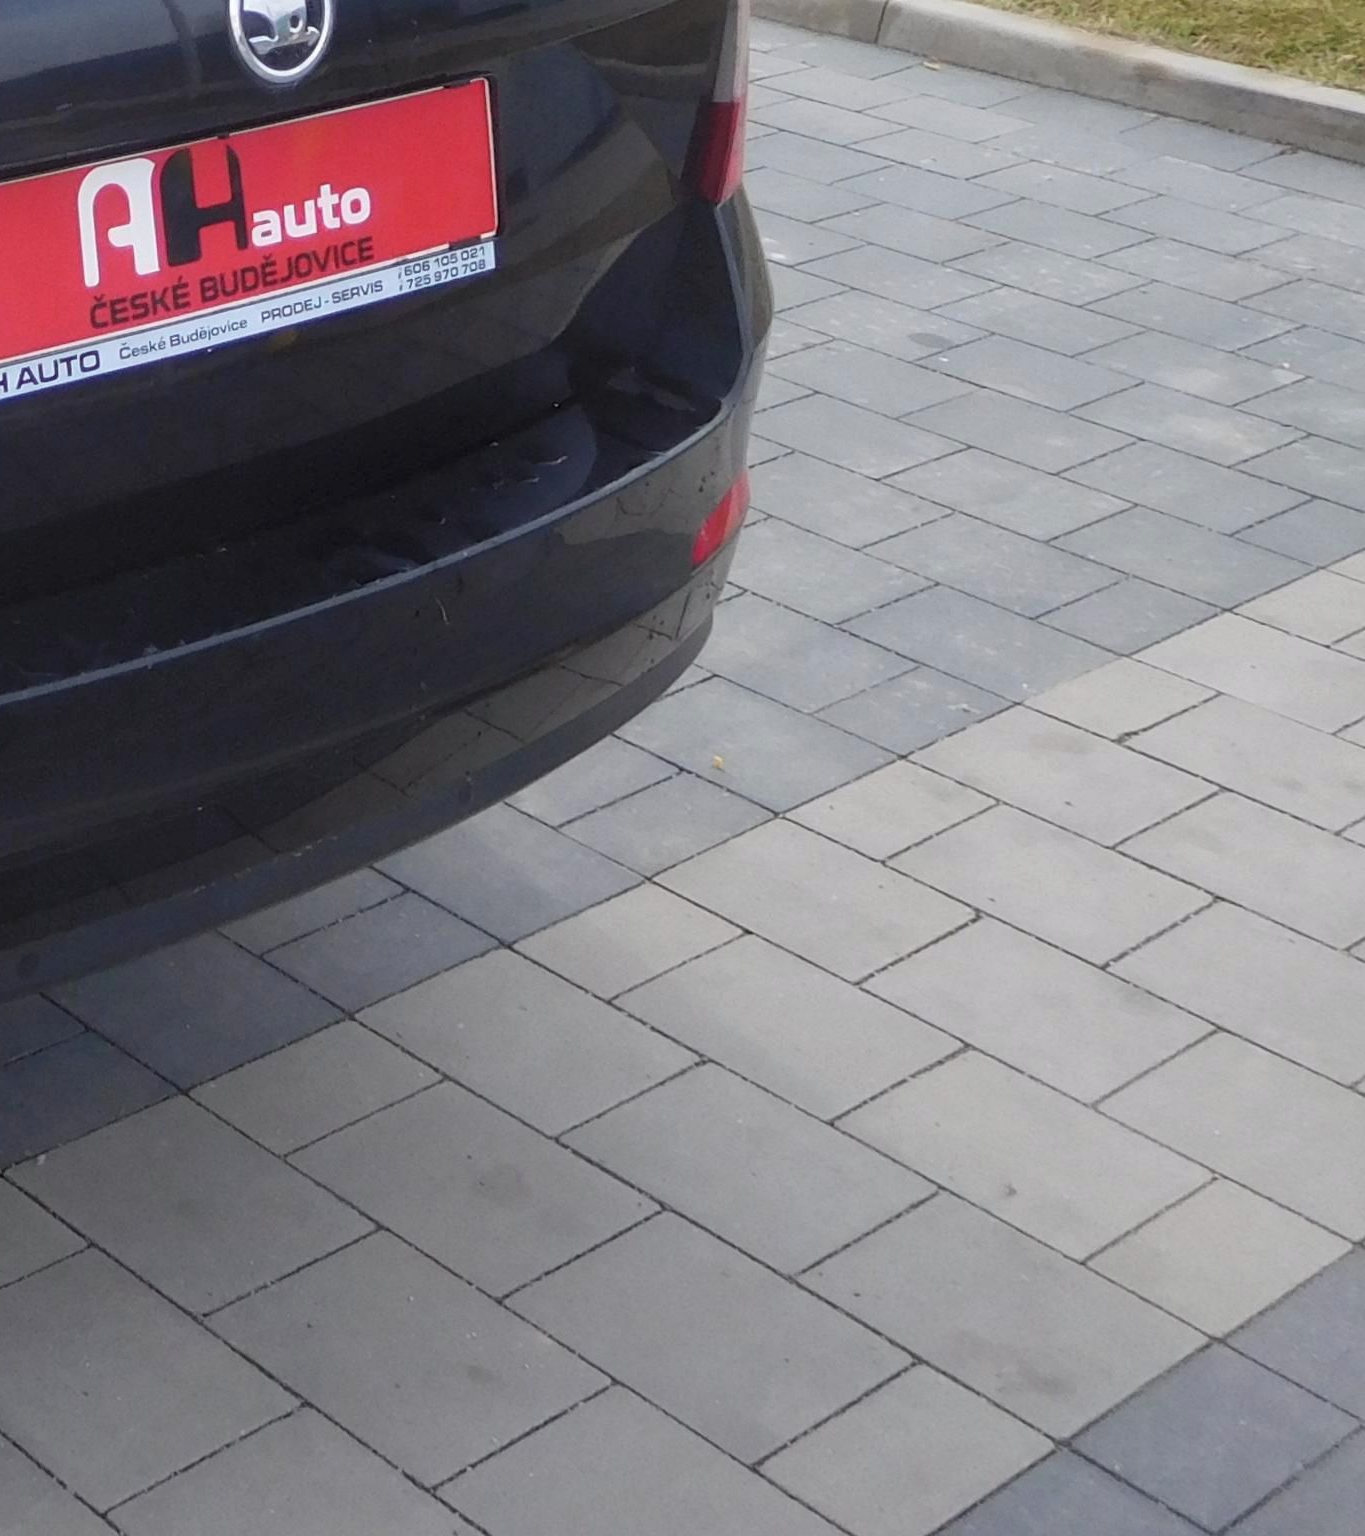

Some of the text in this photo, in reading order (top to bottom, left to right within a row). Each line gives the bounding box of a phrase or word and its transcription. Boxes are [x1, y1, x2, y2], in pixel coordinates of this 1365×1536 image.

[251, 183, 372, 247] auto
[89, 236, 375, 330] ČESKÉ BUDĚJOVICE
[404, 246, 485, 277] 606 105 021
[406, 258, 486, 290] 725 970 708
[15, 349, 101, 390] AUTO
[119, 336, 166, 360] České
[170, 319, 248, 348] Budějovice
[261, 297, 323, 324] PRODEJ
[331, 279, 384, 305] SERVIS
